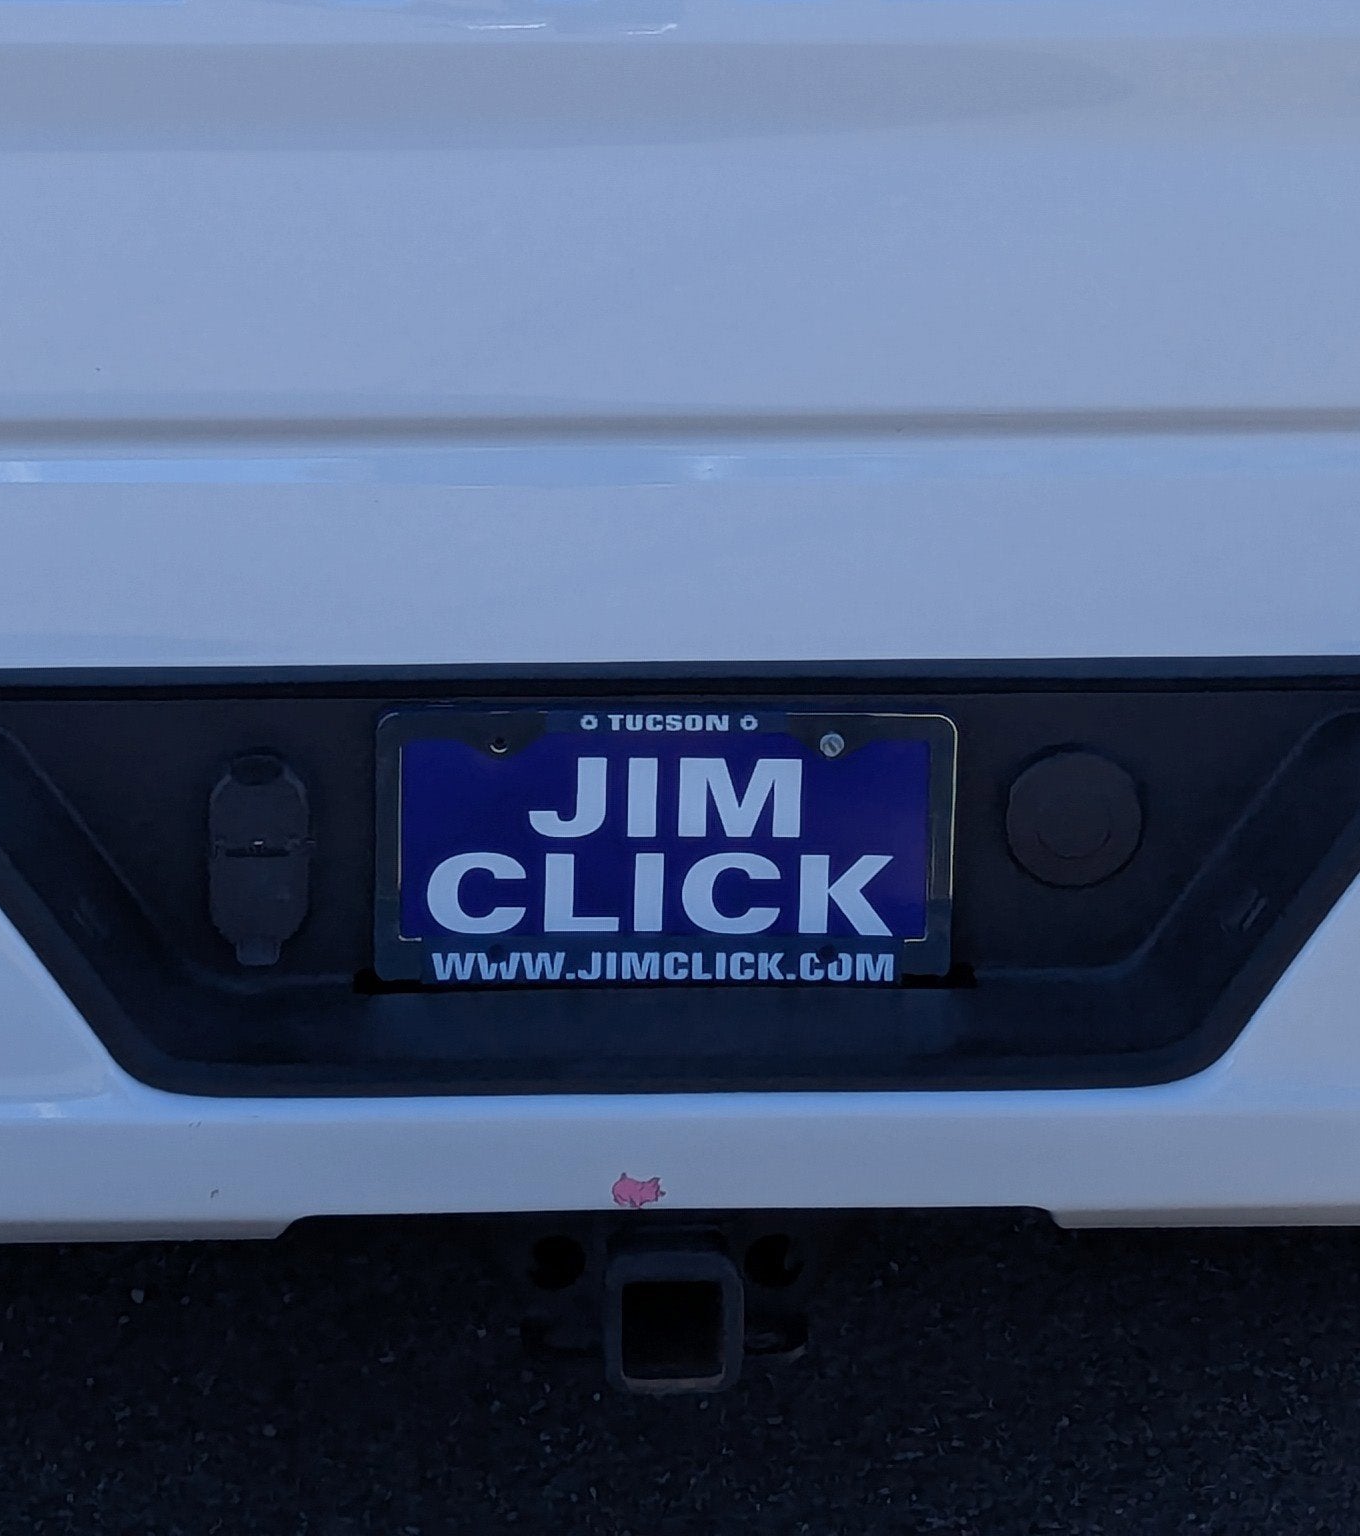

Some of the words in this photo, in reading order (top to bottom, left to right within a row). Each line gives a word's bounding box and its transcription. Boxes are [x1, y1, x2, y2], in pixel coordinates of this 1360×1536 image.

[607, 714, 730, 732] TUCSON
[528, 757, 803, 839] JIM
[426, 852, 894, 937] CLICK
[431, 951, 896, 983] WWW.JIMCLICK.COM
